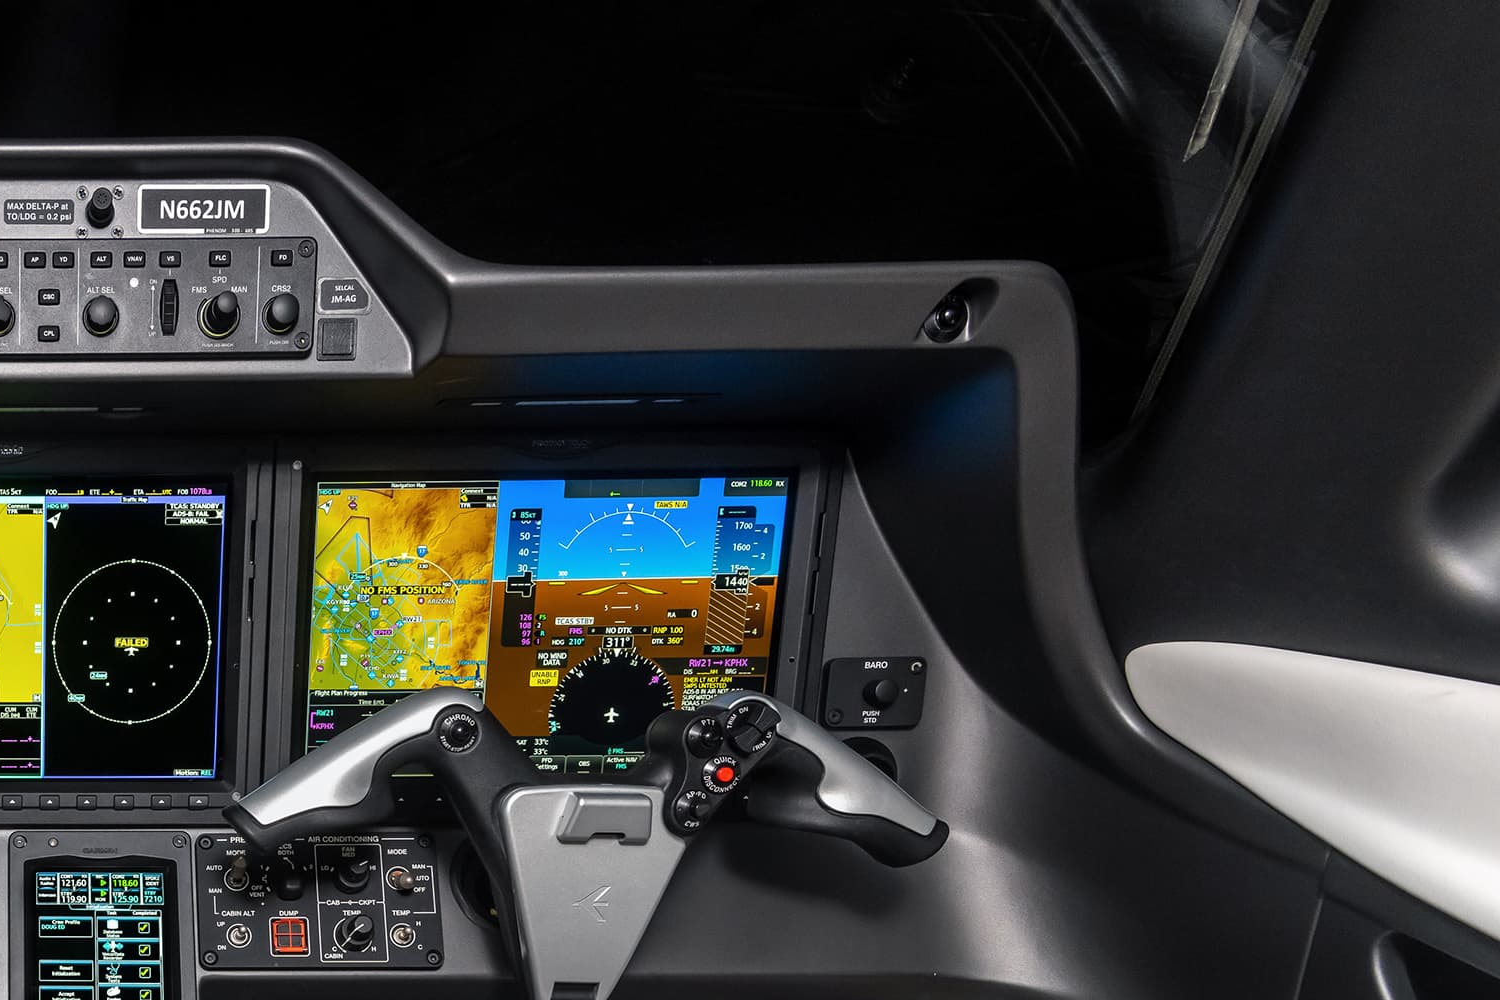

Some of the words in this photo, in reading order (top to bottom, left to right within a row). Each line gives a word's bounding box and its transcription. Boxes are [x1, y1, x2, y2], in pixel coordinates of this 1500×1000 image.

[160, 200, 245, 219] N662JM
[7, 213, 37, 221] TO/LDG
[46, 213, 59, 221] 0.2
[60, 213, 72, 221] psi
[87, 286, 100, 294] ALT
[101, 286, 115, 294] SEL
[331, 294, 357, 303] JM-AG
[750, 479, 773, 487] 118.60
[360, 586, 375, 594] NO
[378, 586, 398, 594] FMS
[400, 586, 445, 594] POSITION
[115, 638, 148, 647] FAILED
[864, 661, 888, 669] BARO
[444, 714, 476, 727] CHRONO
[713, 756, 737, 766] QUICK
